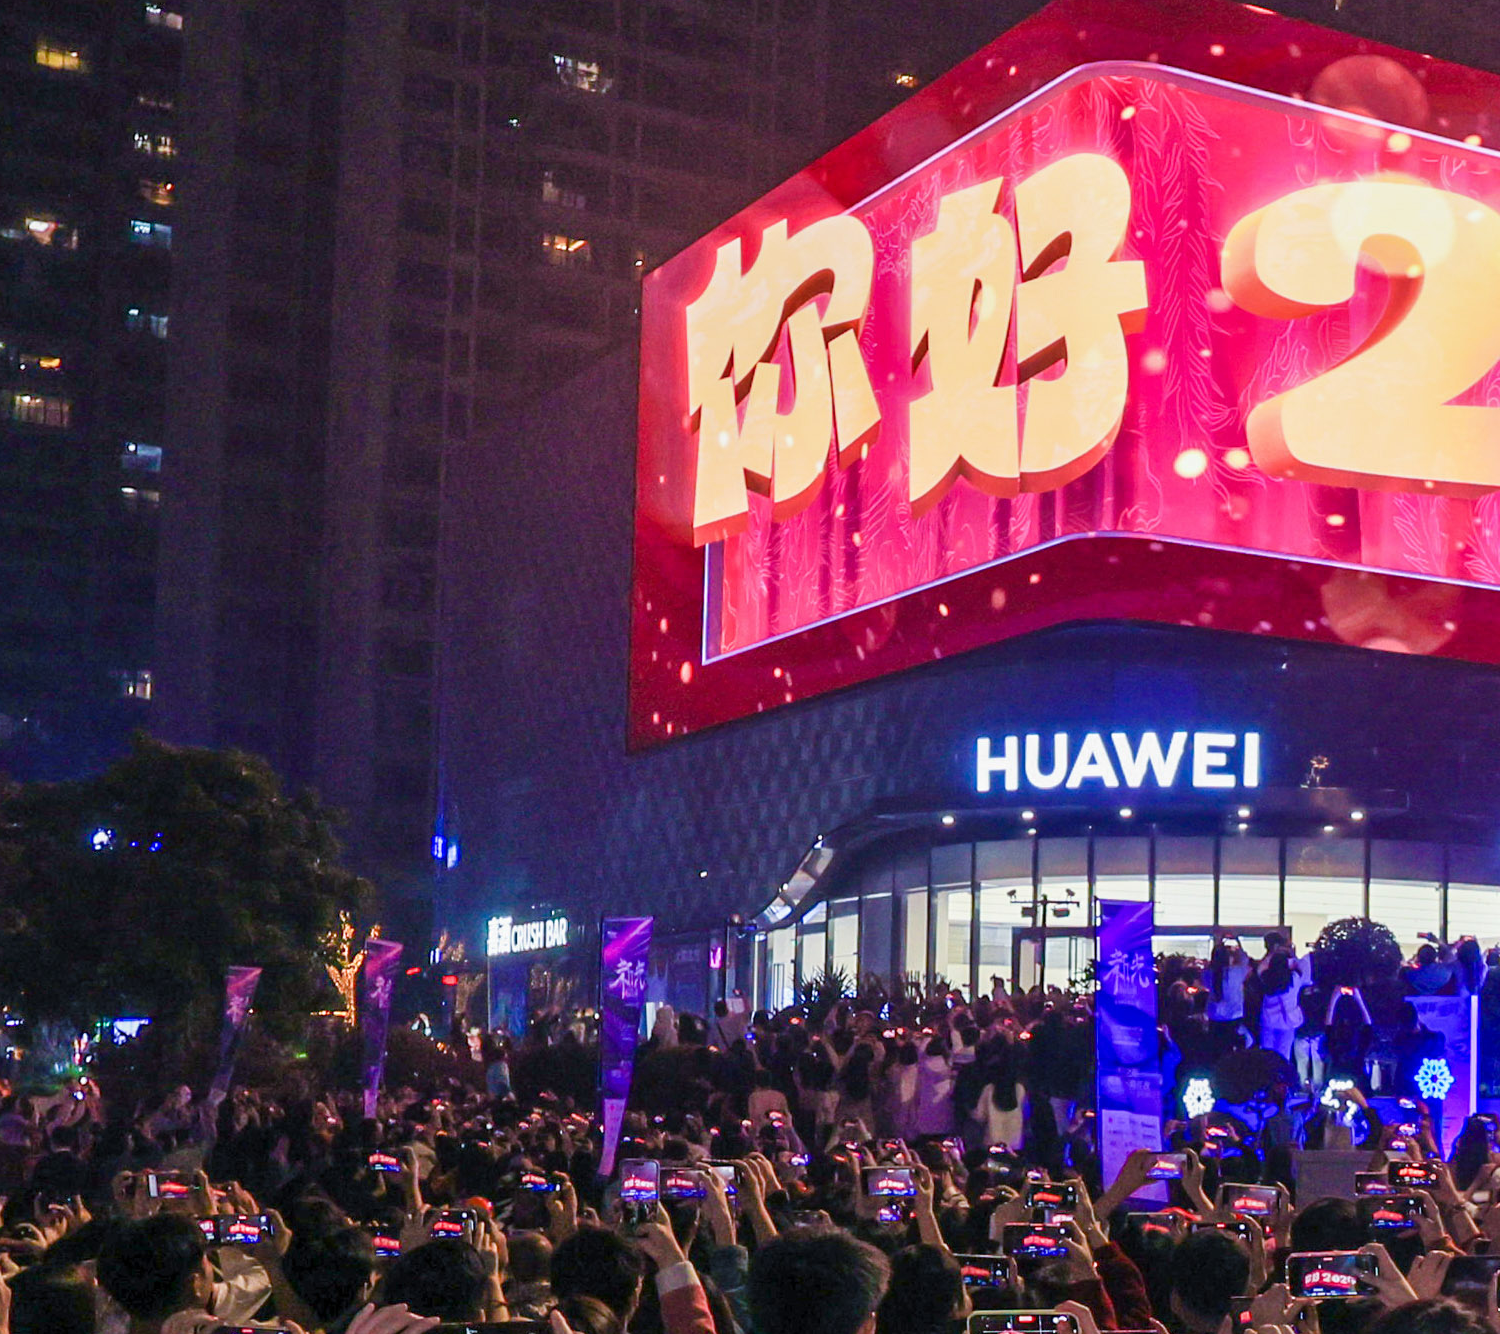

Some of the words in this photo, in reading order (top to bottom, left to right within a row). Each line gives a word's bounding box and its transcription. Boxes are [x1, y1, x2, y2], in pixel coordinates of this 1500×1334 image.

[685, 150, 1148, 548] 你好
[975, 731, 1261, 792] HUAWEI
[511, 920, 544, 953] CRUSH
[545, 917, 568, 948] BAR
